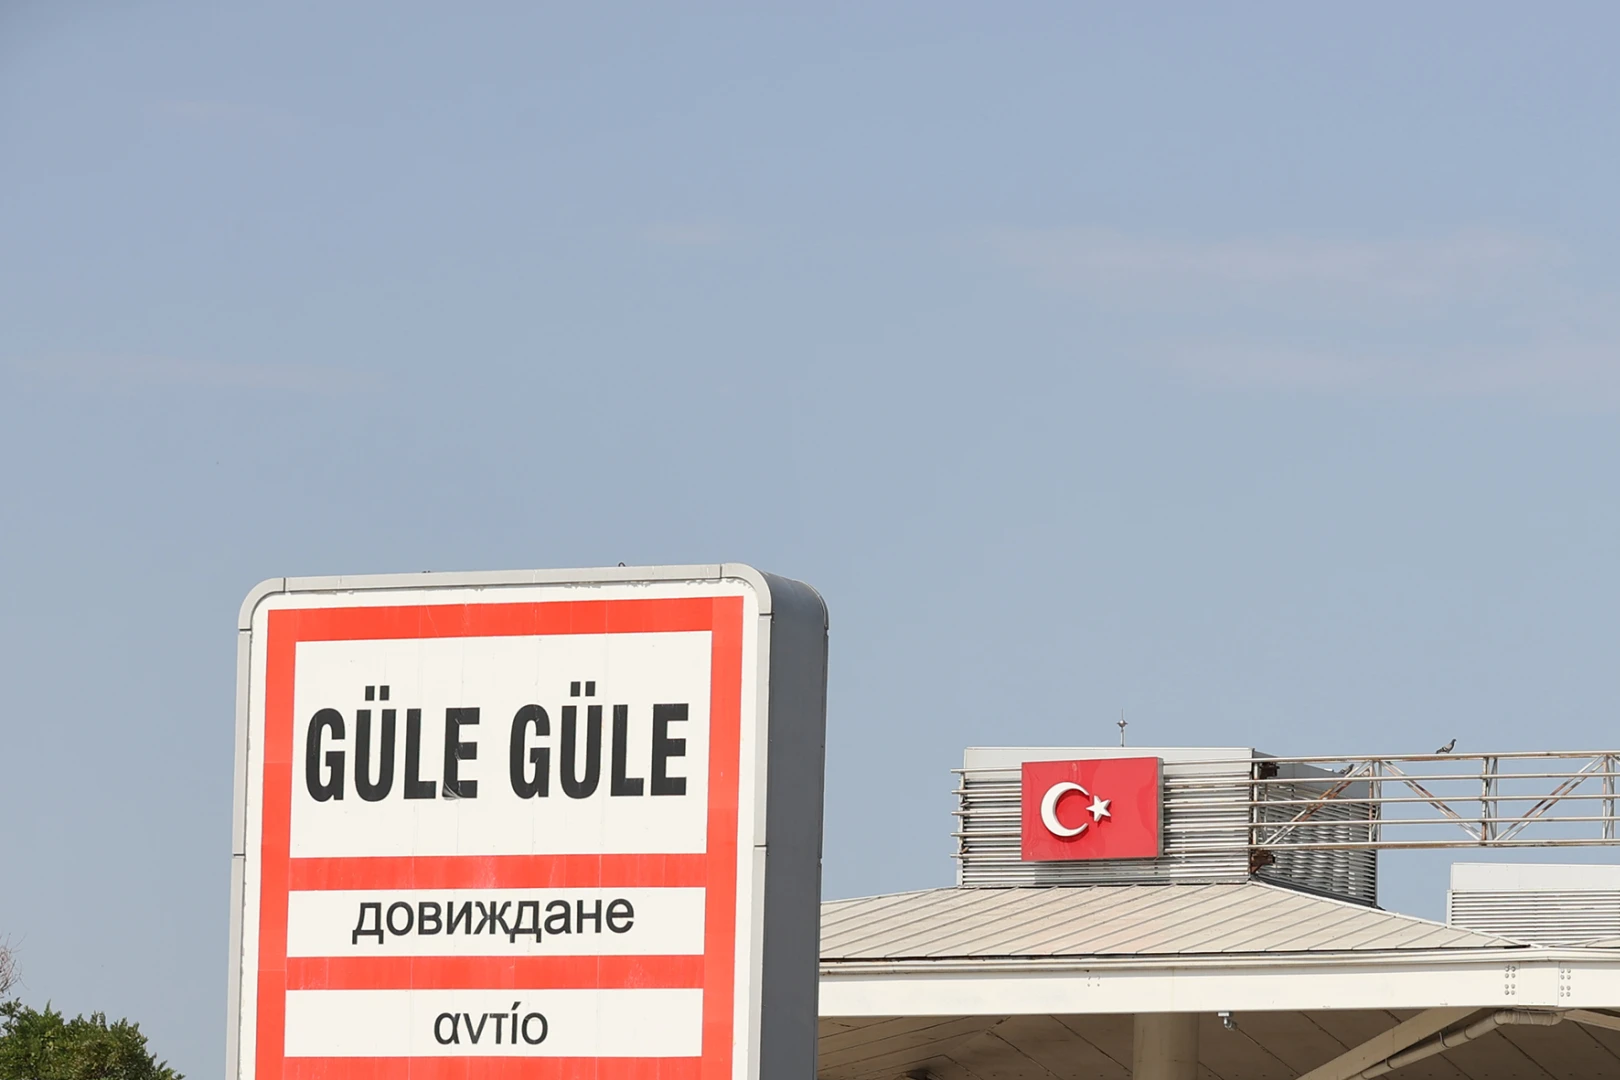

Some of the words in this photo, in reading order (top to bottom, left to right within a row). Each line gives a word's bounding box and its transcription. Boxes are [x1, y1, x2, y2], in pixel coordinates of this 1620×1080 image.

[305, 684, 481, 803] GÜLE
[509, 680, 689, 800] GÜLE
[351, 897, 635, 945] довиждане
[433, 1001, 549, 1046] αντίο
